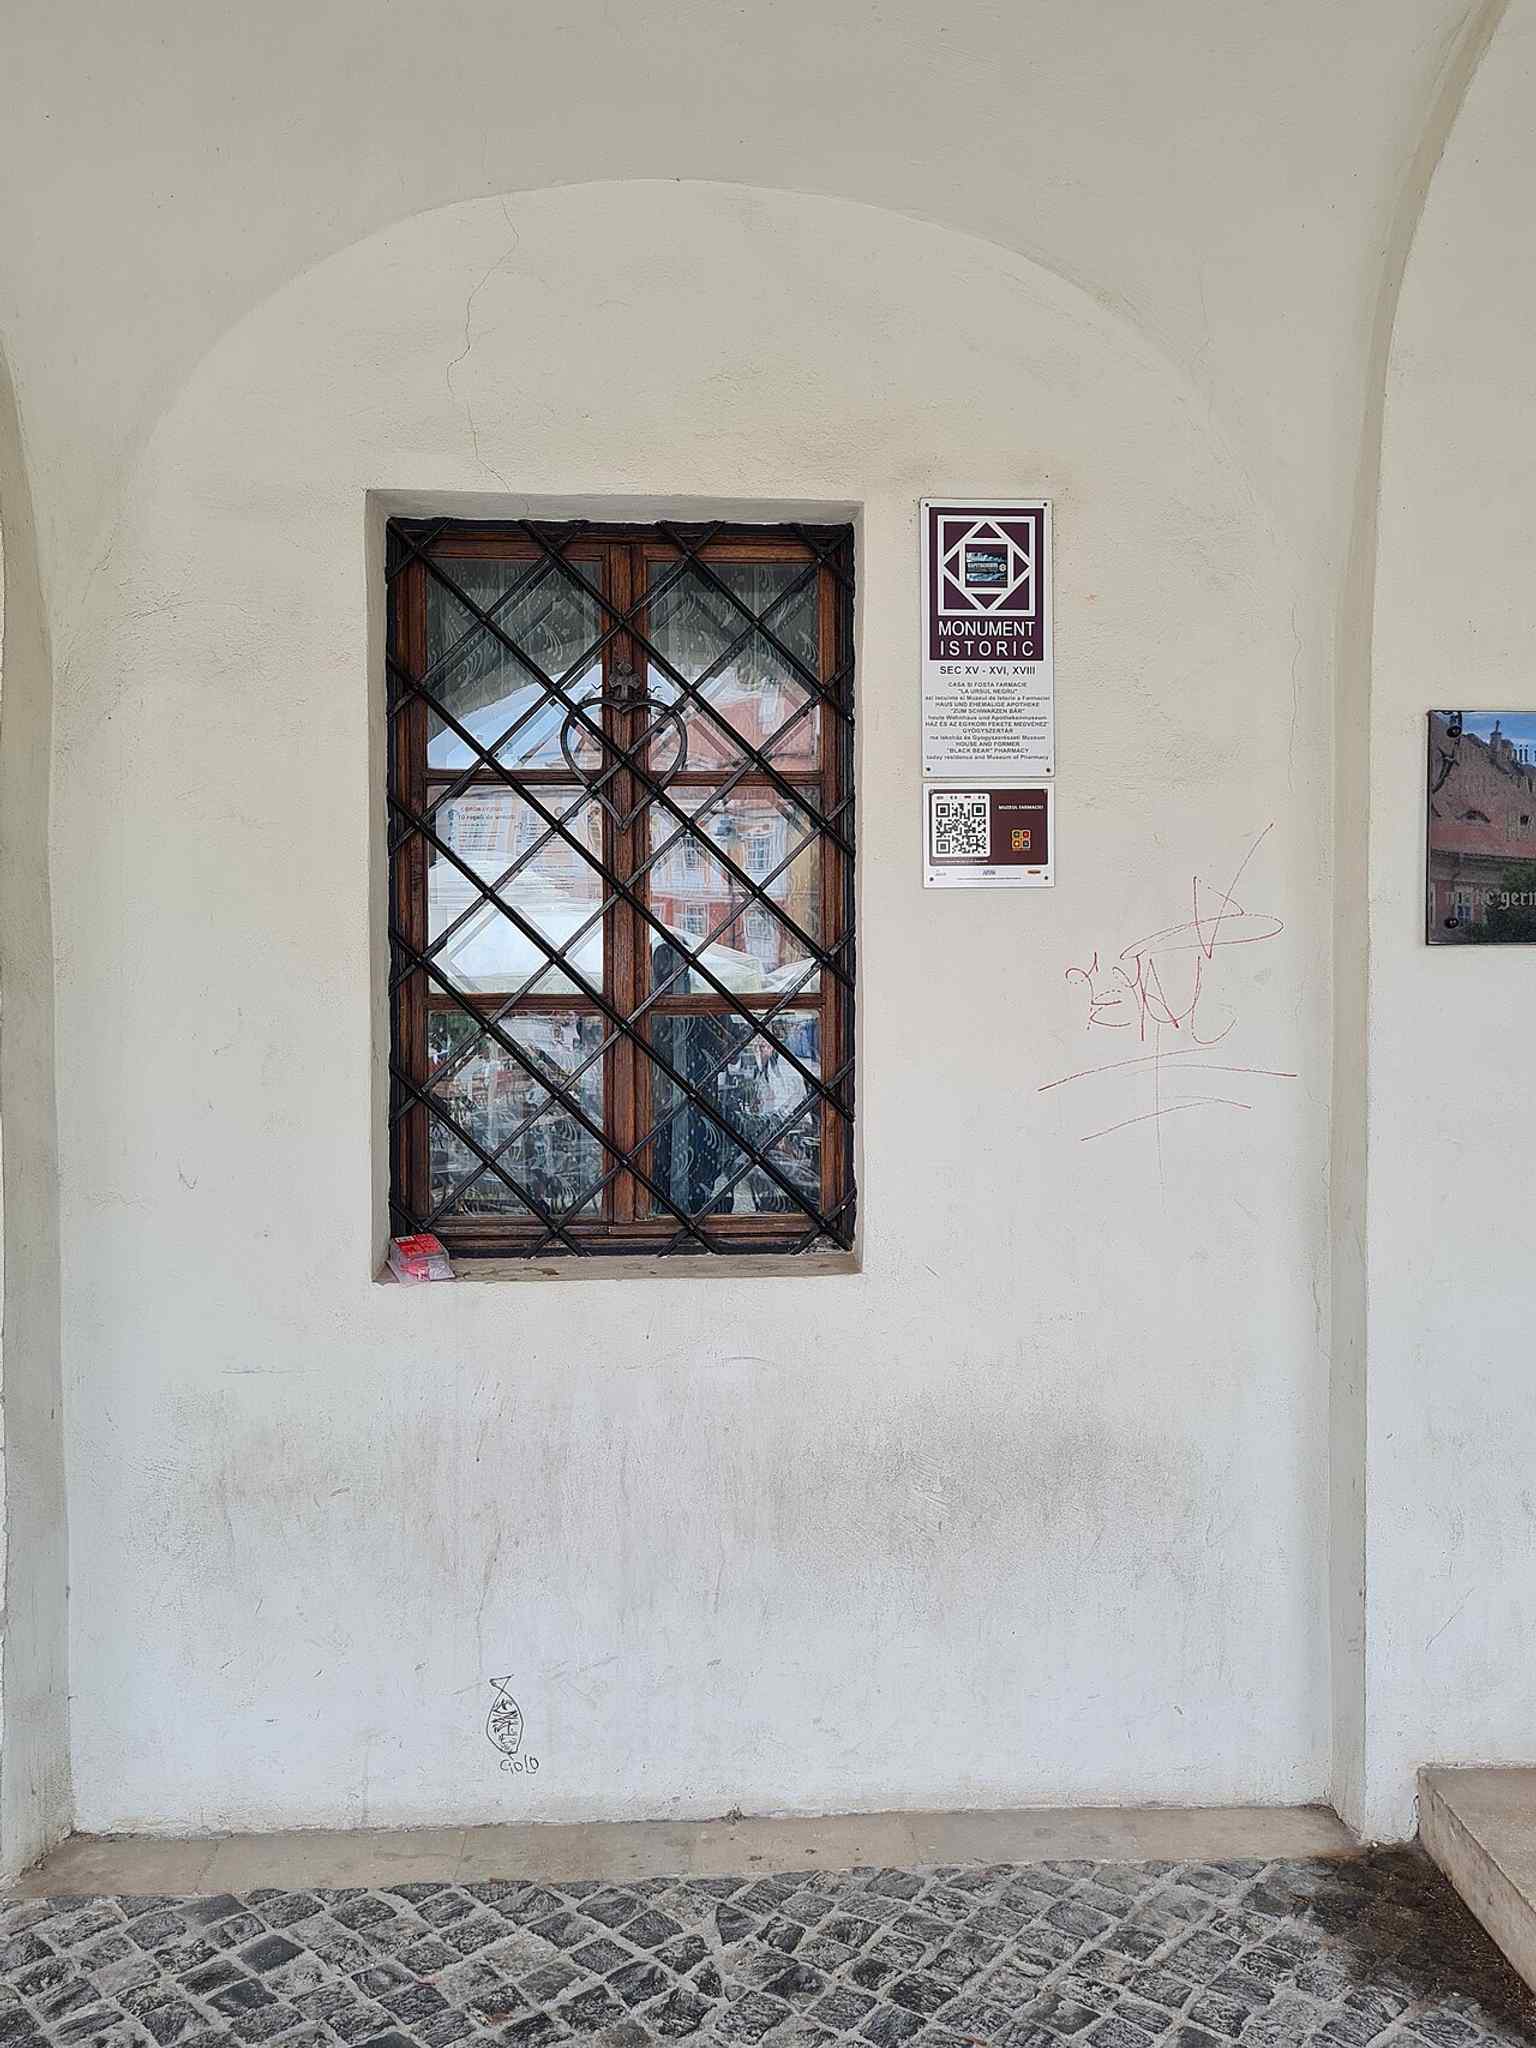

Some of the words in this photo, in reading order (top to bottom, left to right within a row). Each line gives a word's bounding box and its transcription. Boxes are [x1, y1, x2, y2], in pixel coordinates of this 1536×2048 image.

[938, 621, 1036, 636] MONUMENT
[940, 640, 1034, 656] ISTORIC
[939, 666, 961, 674] SEC
[989, 666, 1010, 676] XVI,
[1012, 666, 1035, 674] XVIII
